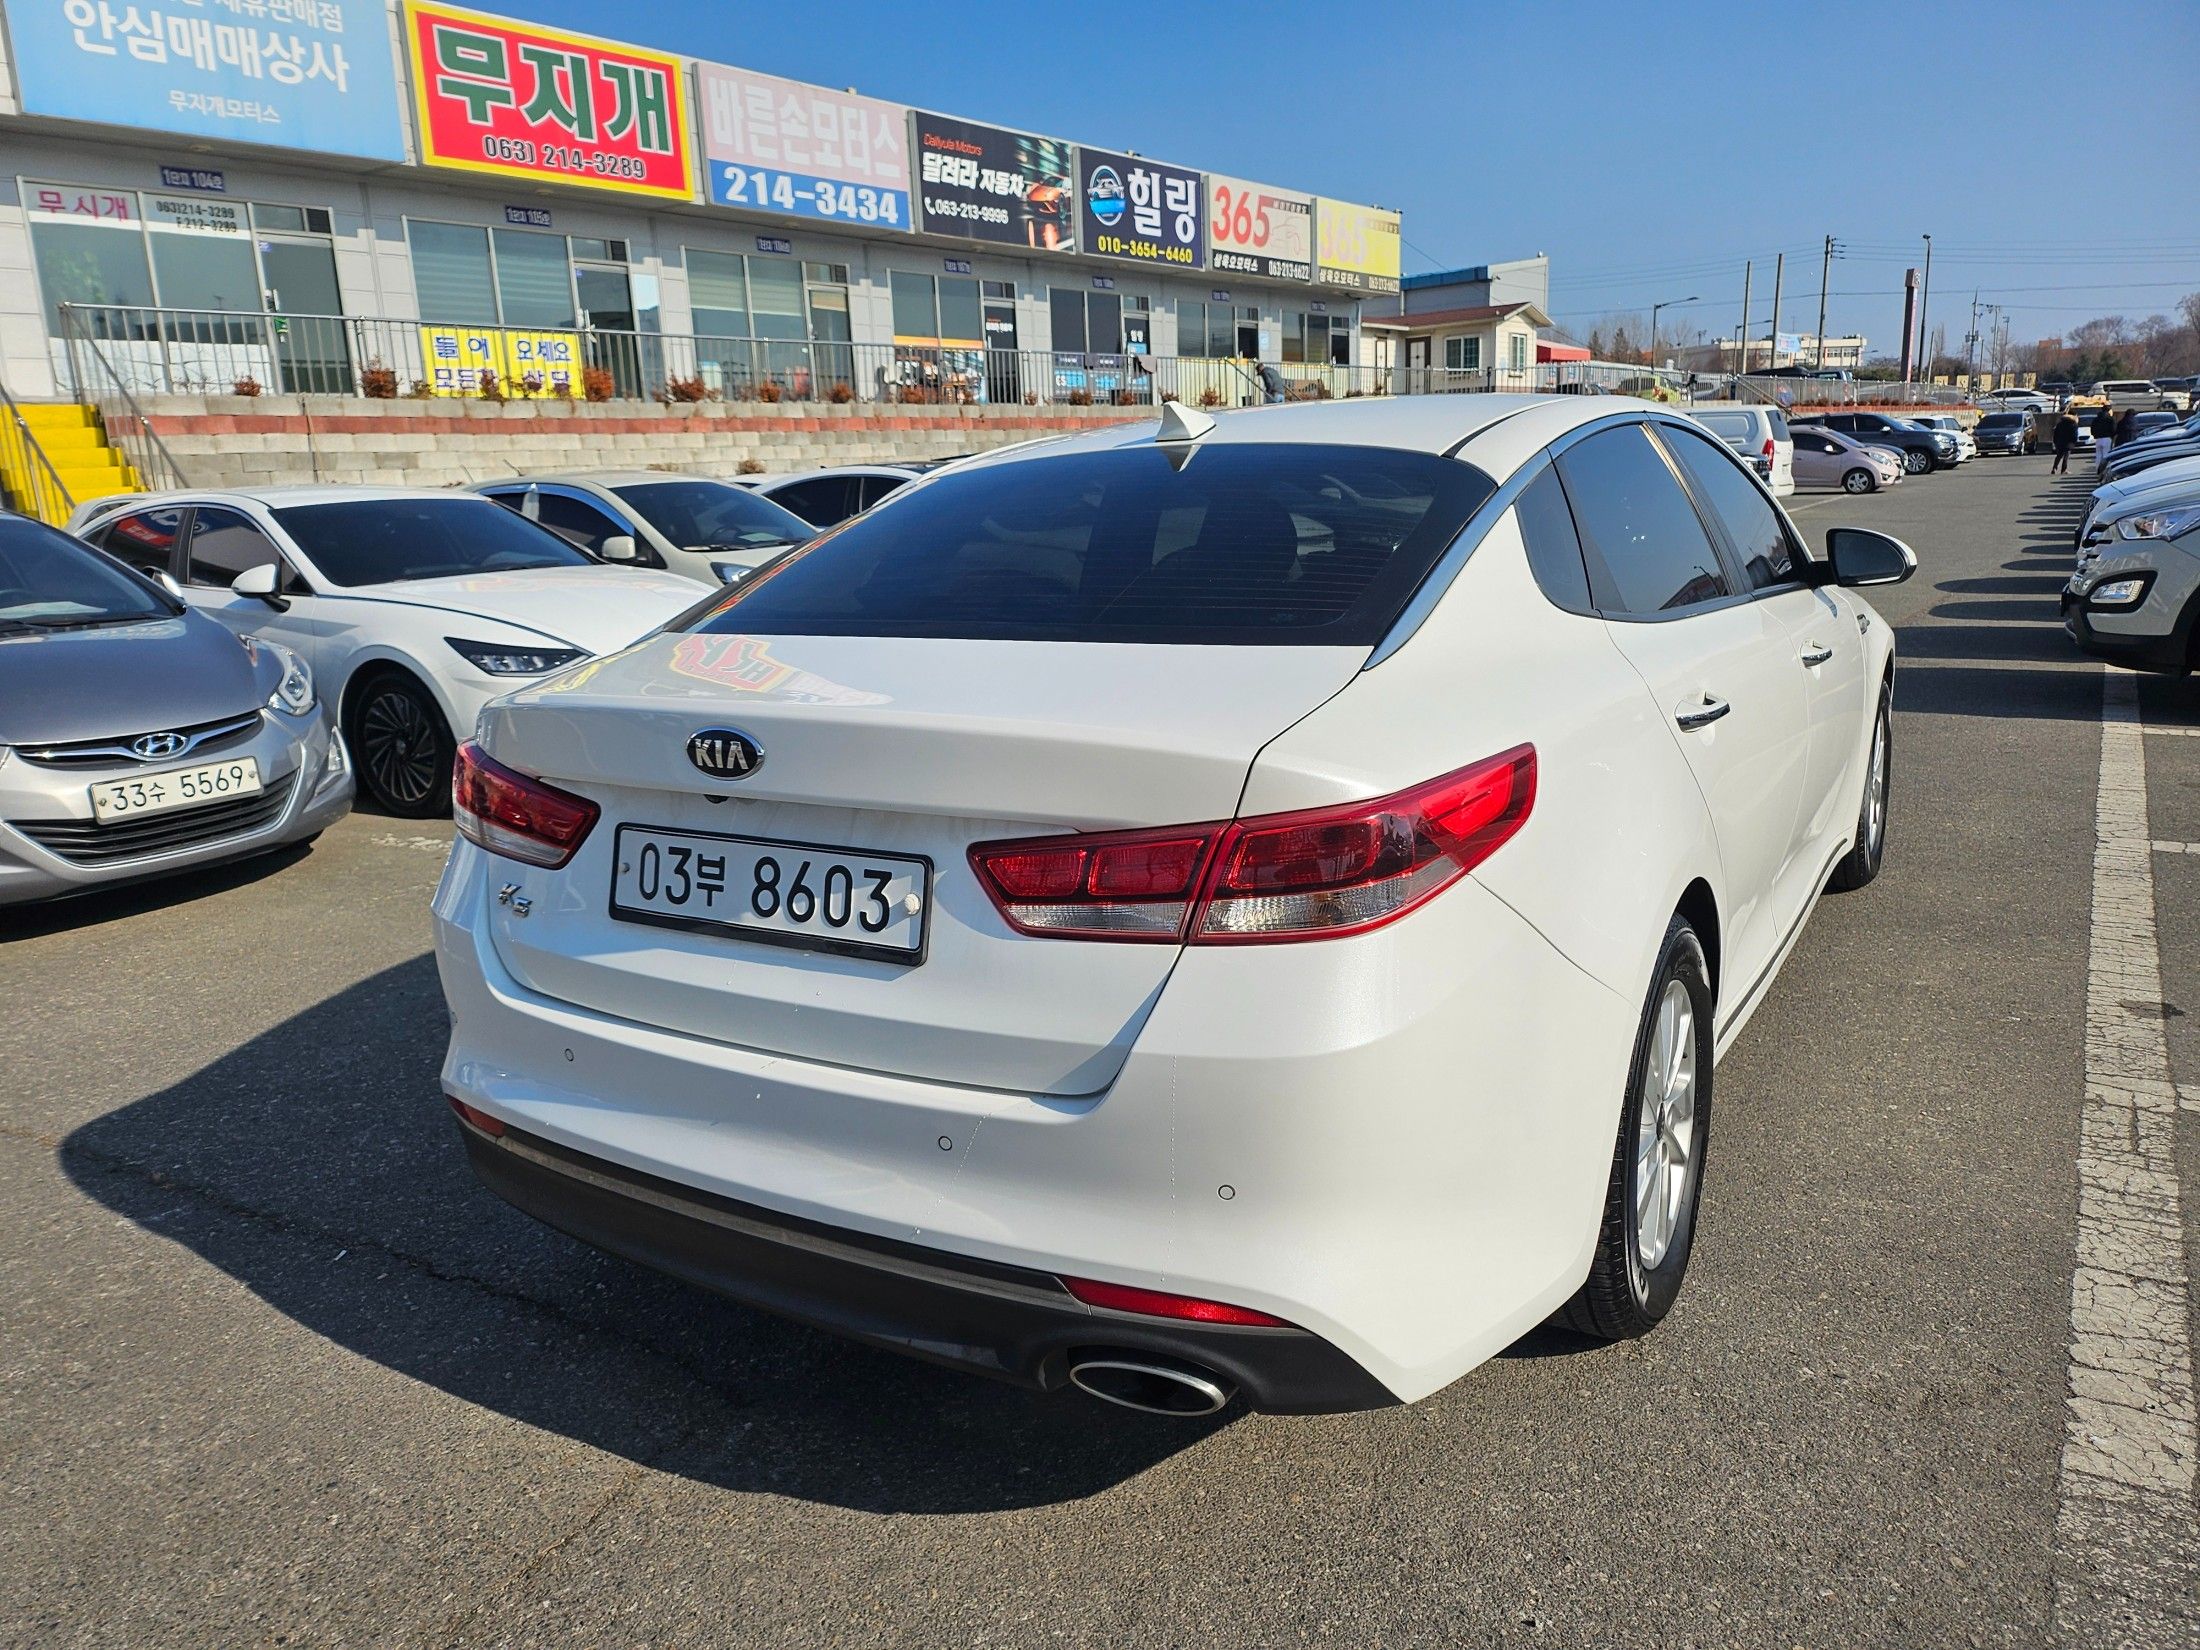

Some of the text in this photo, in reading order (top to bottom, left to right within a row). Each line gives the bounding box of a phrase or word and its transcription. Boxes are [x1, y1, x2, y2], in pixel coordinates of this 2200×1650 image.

[63, 0, 350, 93] 안심매매상사
[168, 89, 282, 124] 무지개모터스
[432, 24, 674, 156] 무지개
[708, 76, 902, 179] 바른손모터스
[483, 135, 647, 180] 063) 214-3289
[922, 151, 1025, 199] 달려라 자동차
[723, 166, 899, 225] 214-3434
[1127, 167, 1197, 244] 힐링
[1212, 185, 1271, 249] 365
[1097, 235, 1193, 264] 010-3654-6460
[517, 341, 570, 362] 오세요
[694, 738, 749, 770] KIA
[110, 766, 244, 811] 33수 5569
[639, 842, 893, 933] 03부 8603
